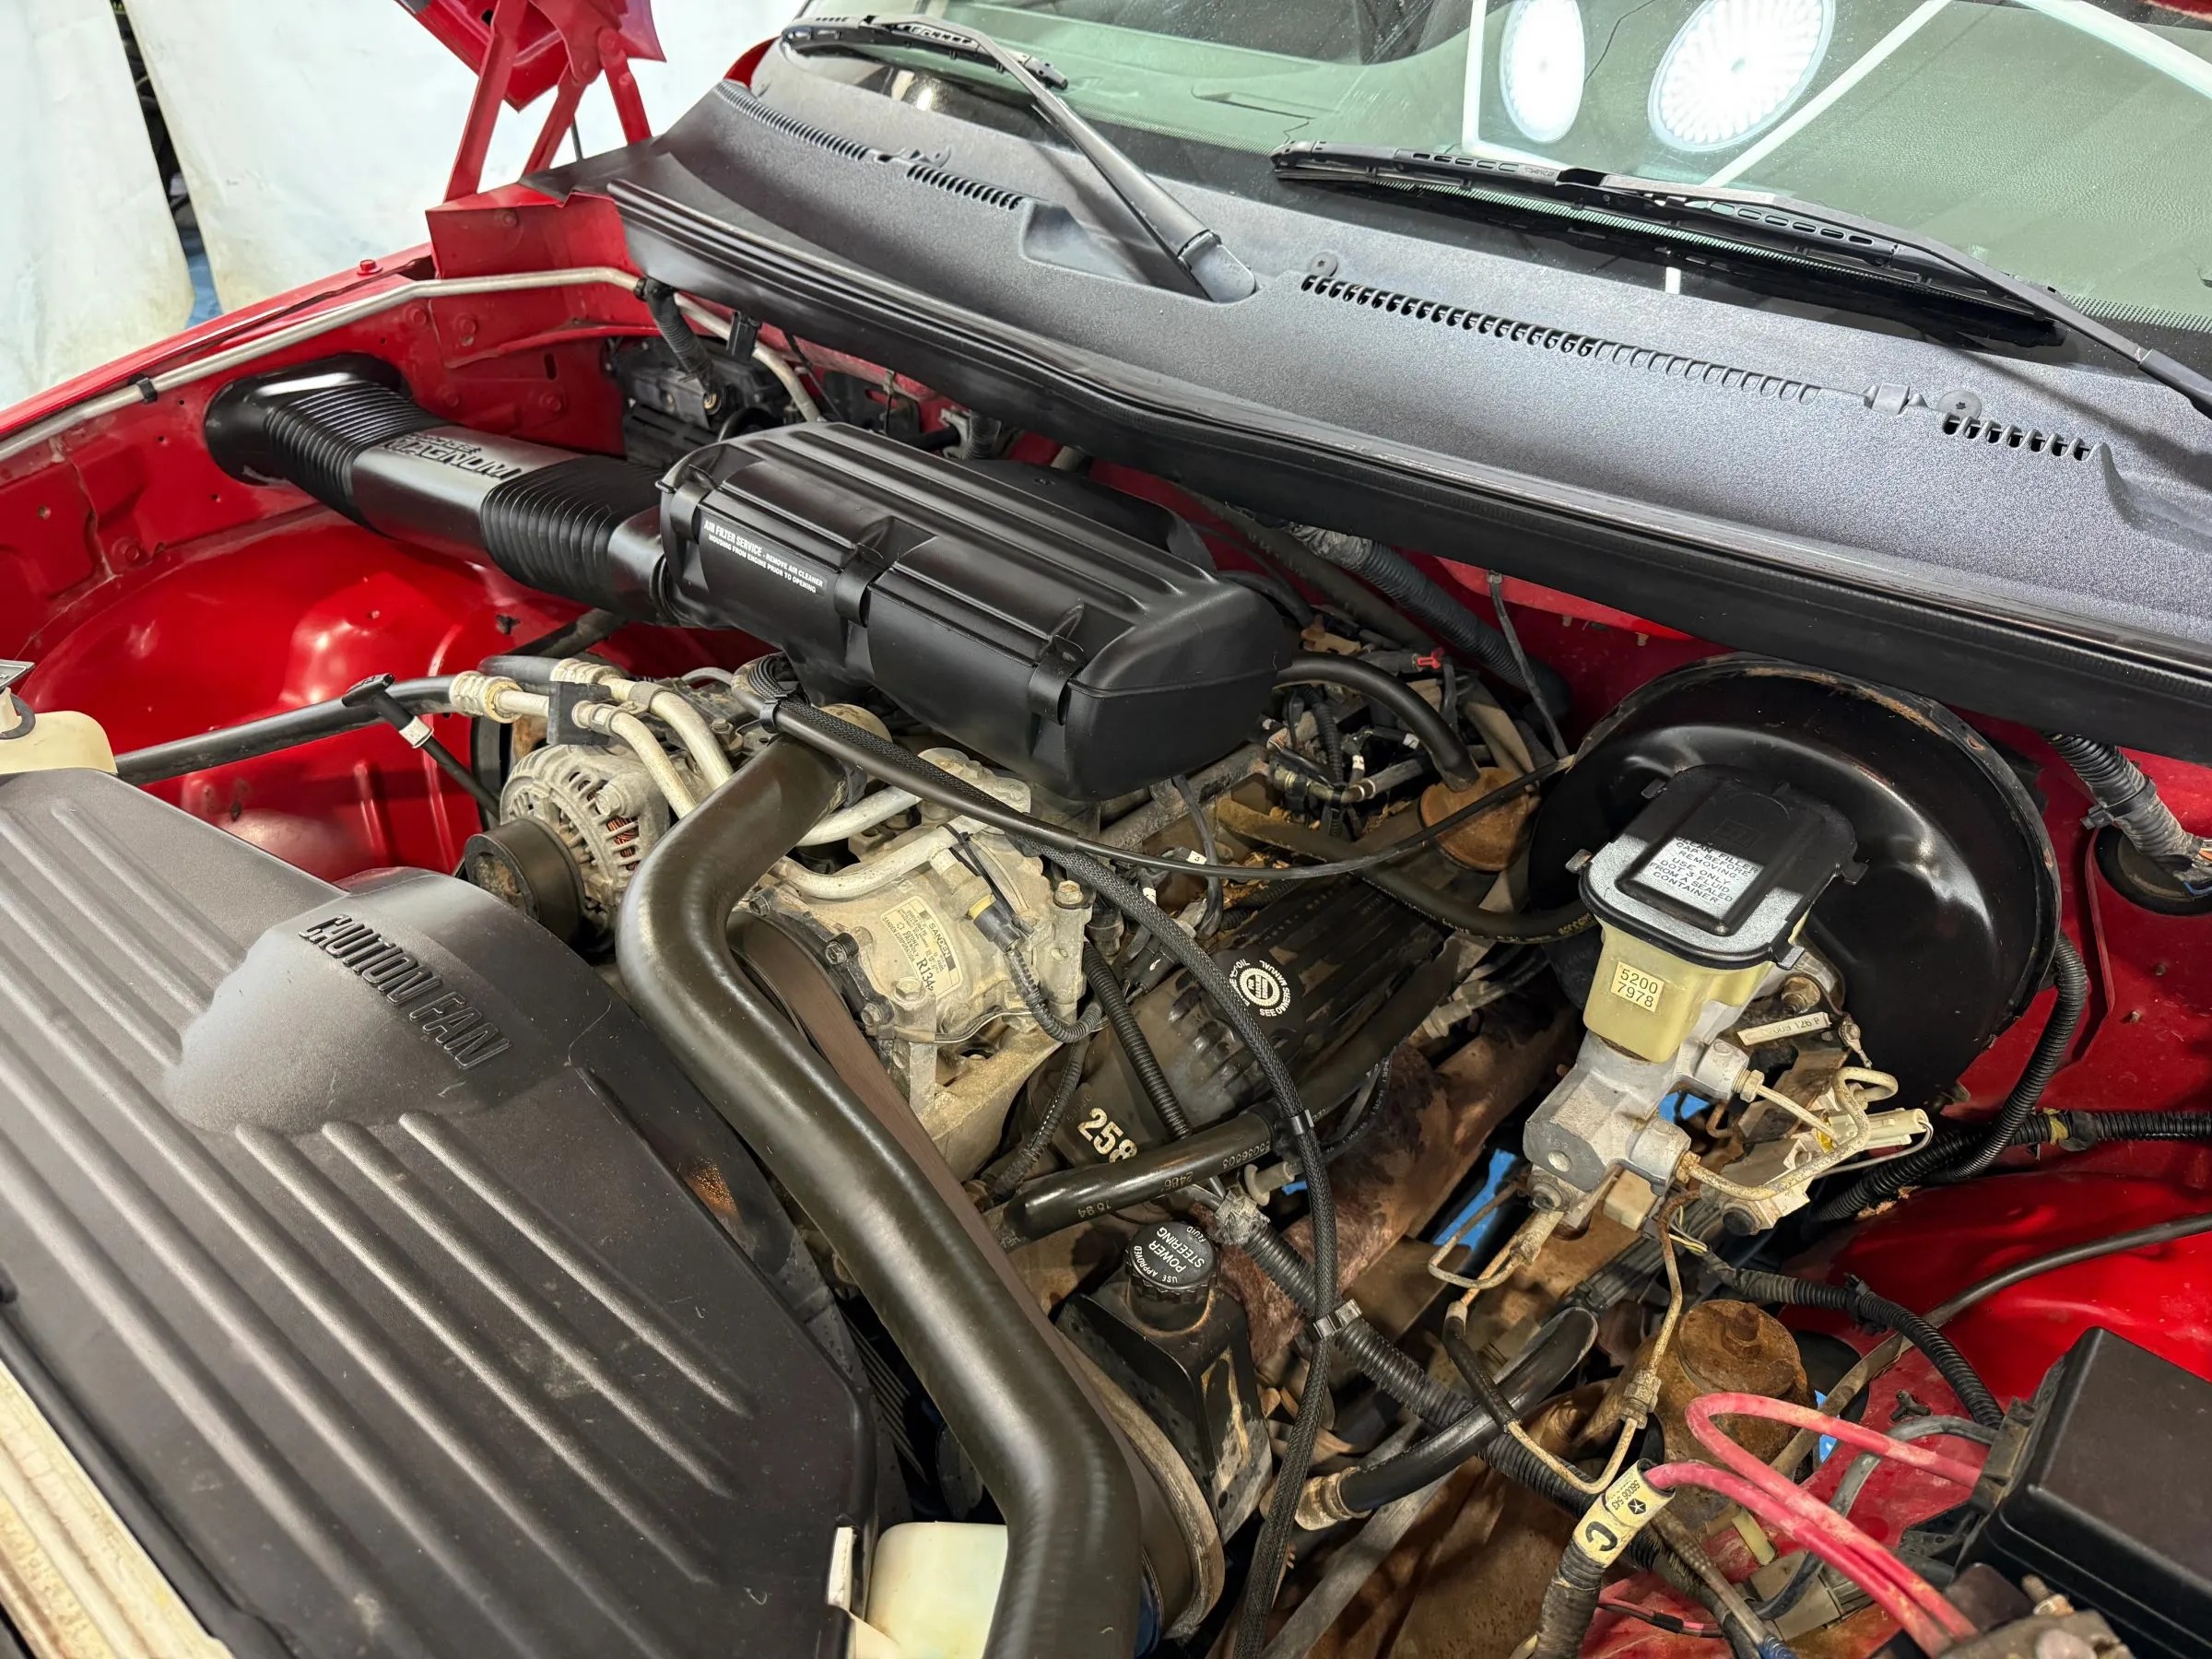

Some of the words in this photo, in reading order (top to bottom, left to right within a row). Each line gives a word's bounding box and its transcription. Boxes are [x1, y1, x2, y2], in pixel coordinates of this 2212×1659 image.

[383, 439, 522, 480] MAGNUM
[703, 520, 715, 534] AIR
[715, 524, 736, 544] FILTER
[735, 533, 763, 556] SERVICE
[766, 554, 788, 570] REMOVE
[788, 565, 798, 575] AIR
[797, 570, 824, 588] CLEANER
[708, 534, 732, 551] HOUSING
[732, 546, 747, 559] FROM
[747, 553, 767, 569] ENGINE
[767, 562, 783, 577] PRIOR
[783, 571, 792, 581] TO
[792, 575, 817, 594] OPENING
[1676, 836, 1712, 853] CLEAN
[1718, 853, 1759, 873] FILLER
[1676, 841, 1699, 853] CAP
[1703, 853, 1749, 877] BEFORE
[1649, 862, 1678, 878] FROM
[1691, 881, 1733, 902] SEALED
[1660, 859, 1684, 873] DOT
[1697, 876, 1730, 893] FLUID
[1672, 857, 1696, 871] USE
[1700, 869, 1731, 885] ONLY
[928, 923, 951, 958] SANDEN
[1235, 959, 1251, 969] OIL
[1259, 959, 1288, 986] MANUAL
[298, 913, 443, 1006] CAUTION
[409, 991, 511, 1070] FAN
[1229, 978, 1251, 1006] ENE
[1617, 981, 1654, 1007] 7978
[1620, 969, 1658, 994] 5200
[1259, 1008, 1277, 1017] SEE
[1276, 987, 1291, 1014] OWNERS
[1077, 1107, 1138, 1163] 258
[1156, 1227, 1206, 1268] STEERING
[1186, 1225, 1206, 1242] FLUID
[1134, 1245, 1159, 1277] APPROVED
[1148, 1240, 1187, 1273] POWER
[1161, 1274, 1178, 1283] USE
[1611, 1496, 1624, 1511] 543
[1584, 1521, 1618, 1552] C
